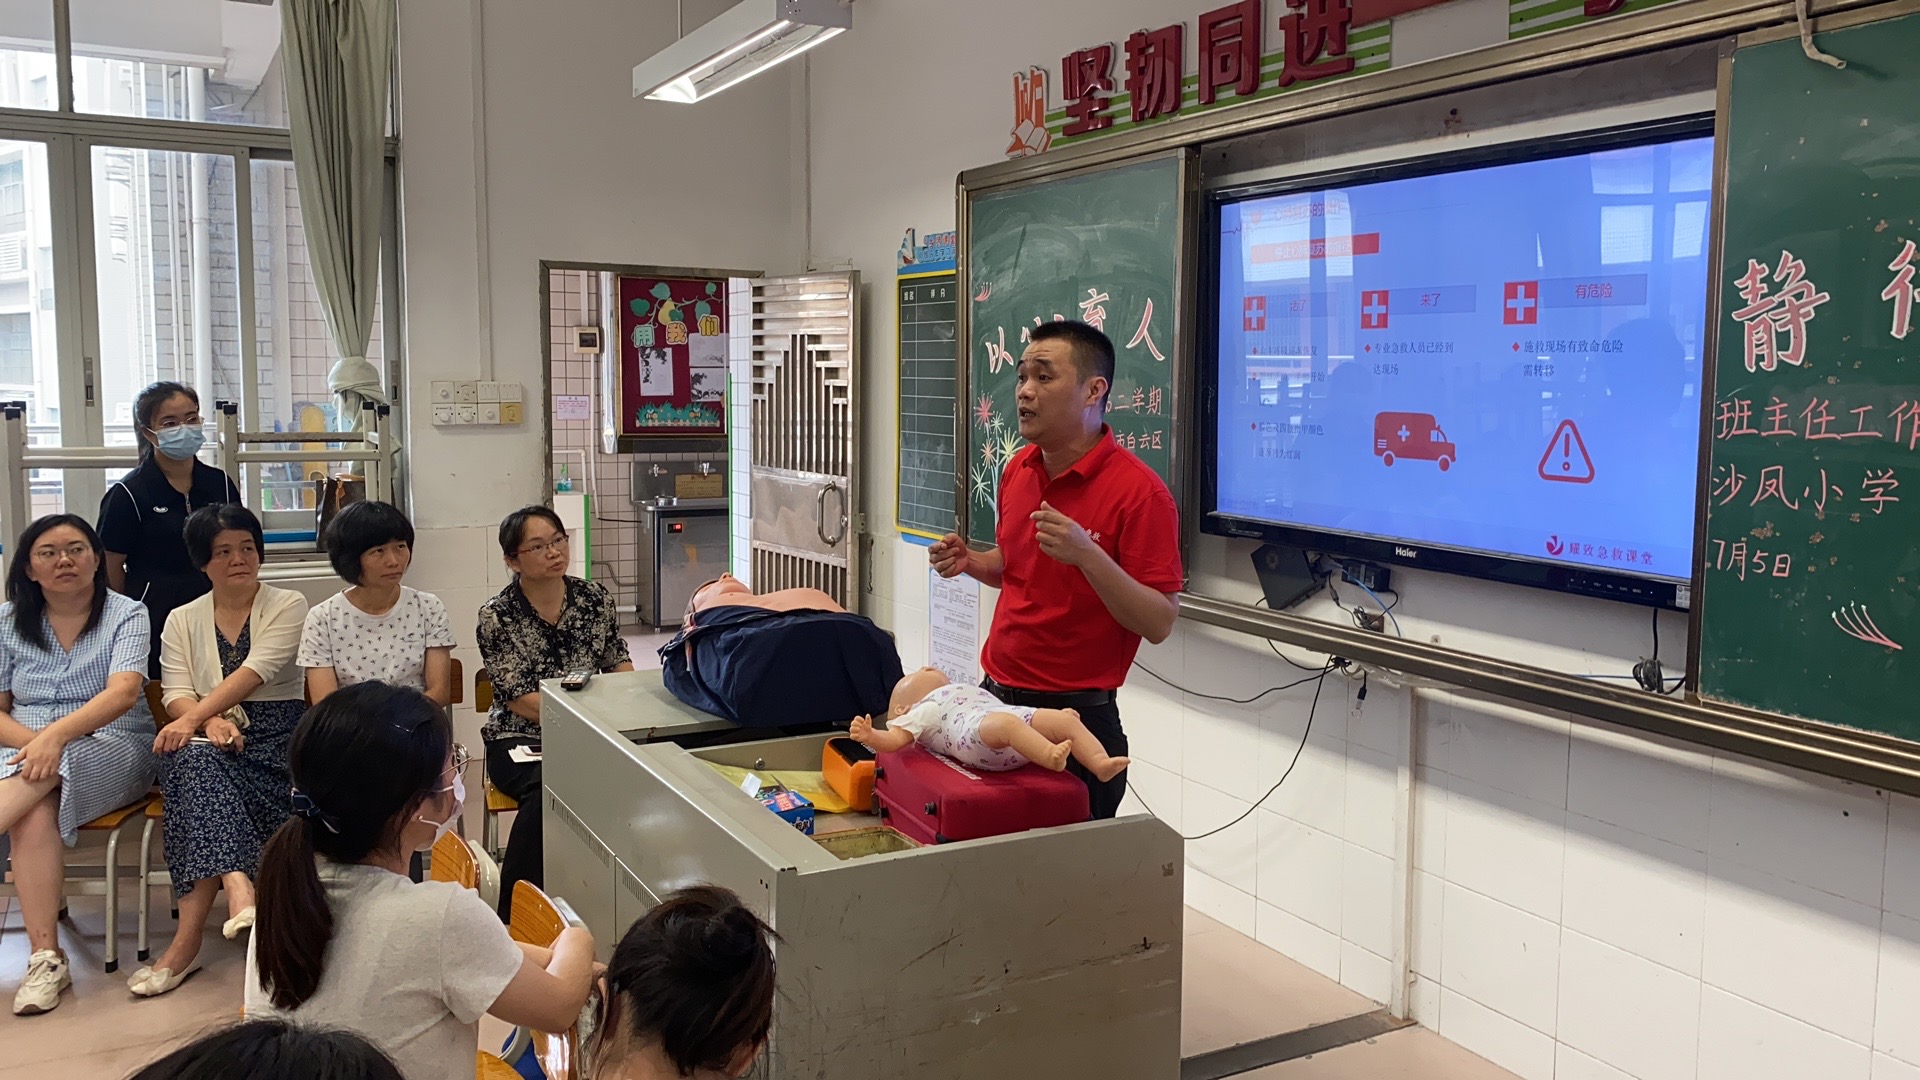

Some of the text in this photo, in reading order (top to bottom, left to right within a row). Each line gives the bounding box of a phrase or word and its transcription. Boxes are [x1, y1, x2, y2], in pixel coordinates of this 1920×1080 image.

[1062, 0, 1355, 137] 坚韧同进
[1574, 283, 1613, 299] 有危险
[1420, 292, 1441, 307] 来了
[1373, 341, 1454, 354] 专业急救人员已经到
[1523, 339, 1624, 354] 施救现场有致命危险
[1373, 364, 1399, 376] 达现场
[1716, 397, 1920, 450] 班主任工作
[1713, 463, 1900, 514] 沙凤小学
[1395, 547, 1417, 558] Haier
[1712, 539, 1791, 581] 7月5日
